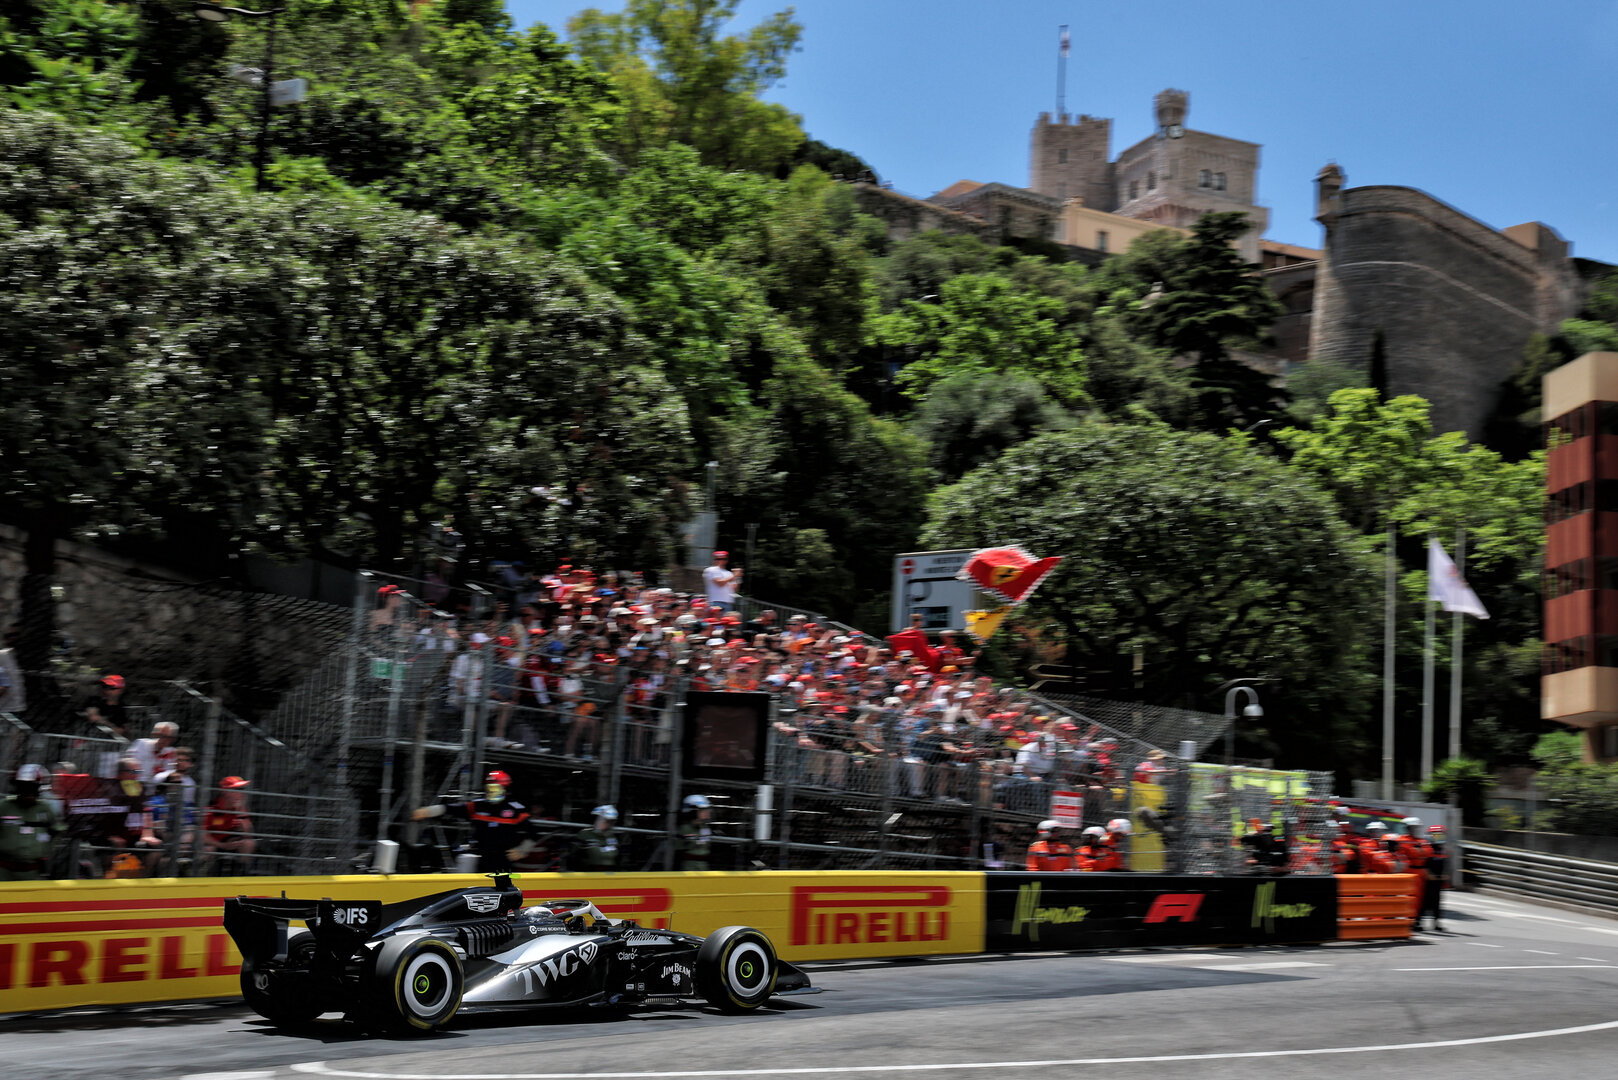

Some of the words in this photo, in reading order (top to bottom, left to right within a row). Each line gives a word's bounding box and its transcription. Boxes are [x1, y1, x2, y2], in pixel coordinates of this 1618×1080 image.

[346, 907, 368, 924] IFS
[789, 886, 953, 945] PIRELLI
[621, 929, 660, 941] Cadillac
[617, 949, 637, 960] Claro
[515, 949, 580, 996] TWG
[661, 965, 674, 979] JIM
[674, 962, 691, 978] BEAM
